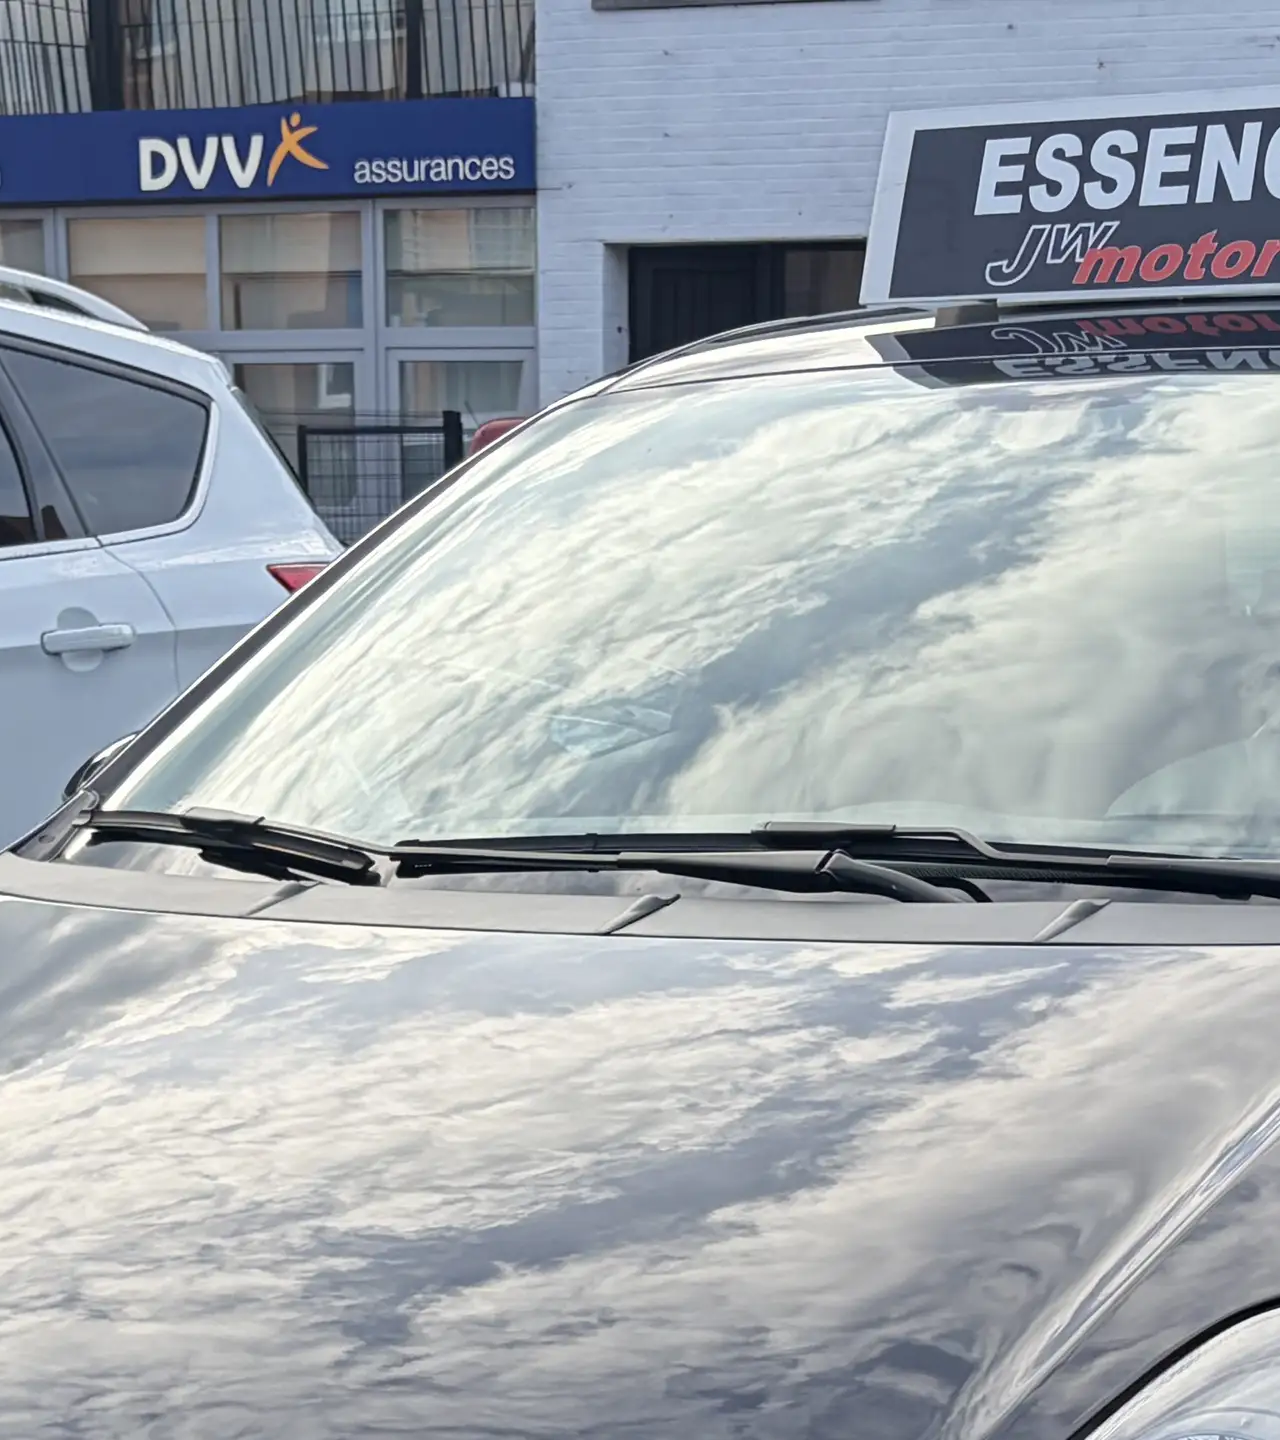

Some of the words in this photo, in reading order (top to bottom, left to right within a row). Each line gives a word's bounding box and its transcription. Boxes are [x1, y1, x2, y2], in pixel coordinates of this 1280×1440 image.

[138, 134, 264, 191] DVV
[353, 153, 515, 185] assurances
[985, 221, 1120, 287] JW
